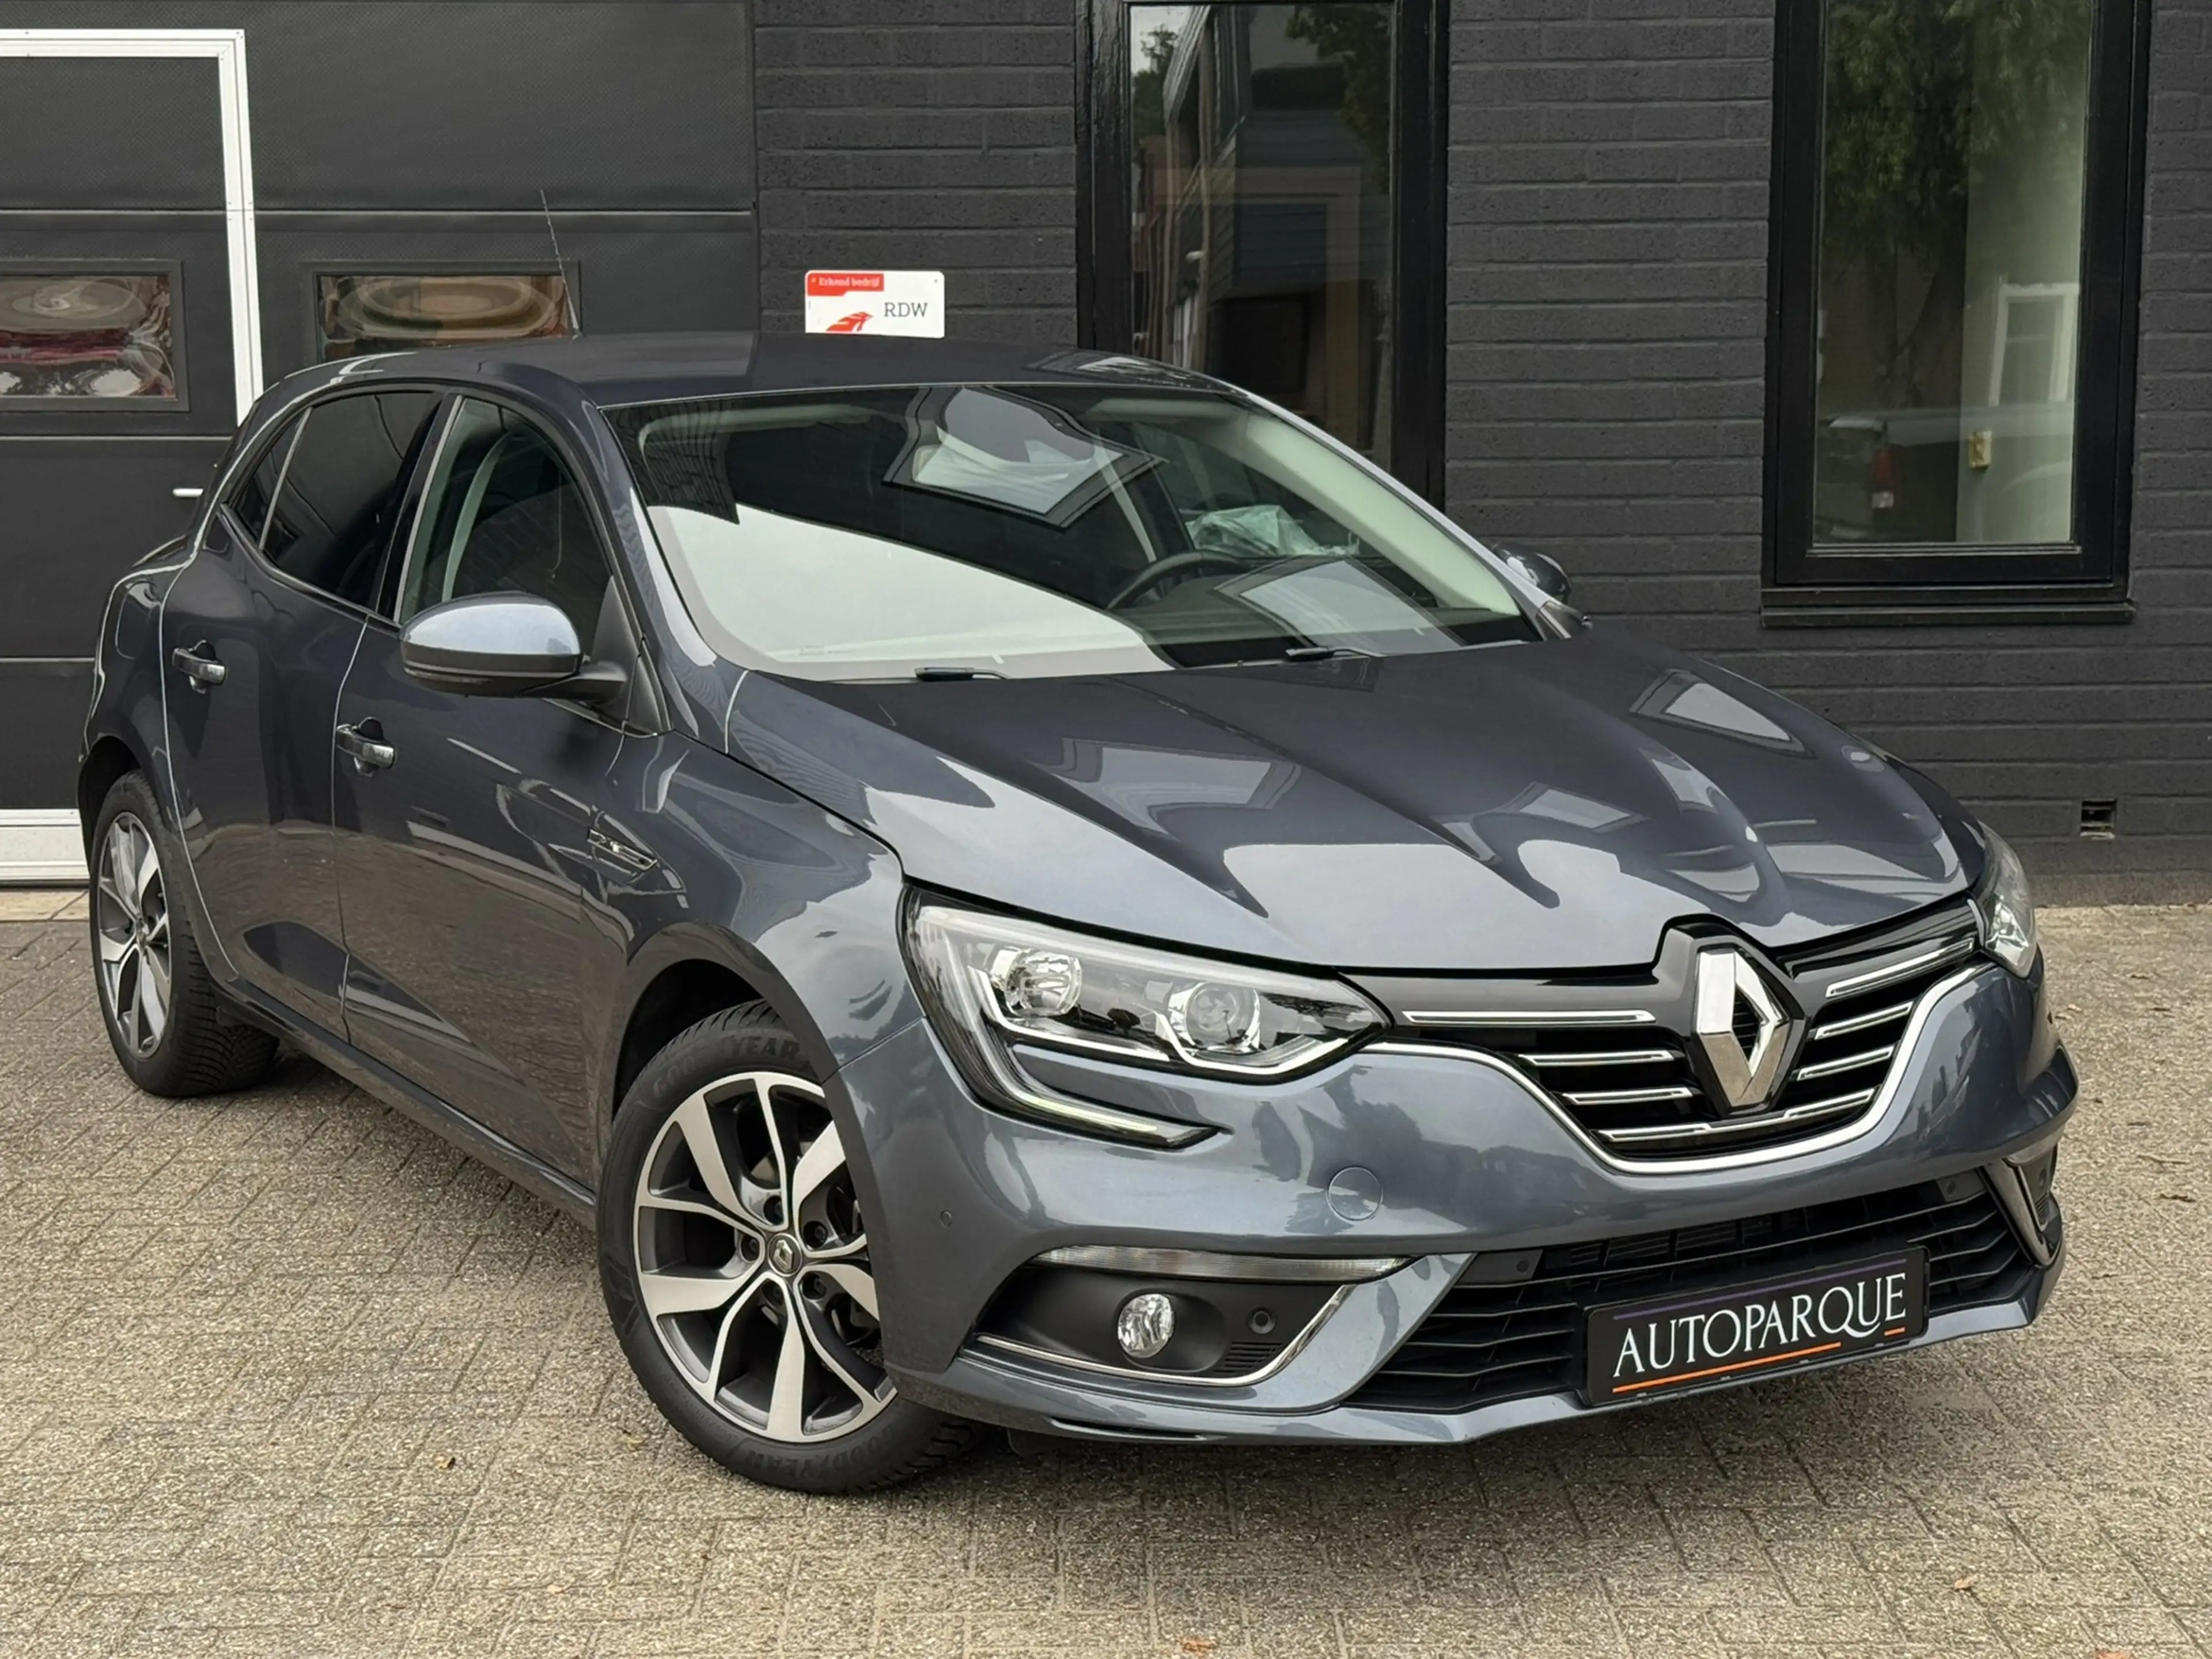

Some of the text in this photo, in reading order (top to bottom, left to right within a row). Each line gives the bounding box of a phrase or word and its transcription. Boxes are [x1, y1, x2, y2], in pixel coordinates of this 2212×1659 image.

[819, 276, 850, 286] Erkend
[884, 302, 928, 318] RDW
[1613, 1272, 1906, 1378] AUTOPARQUE
